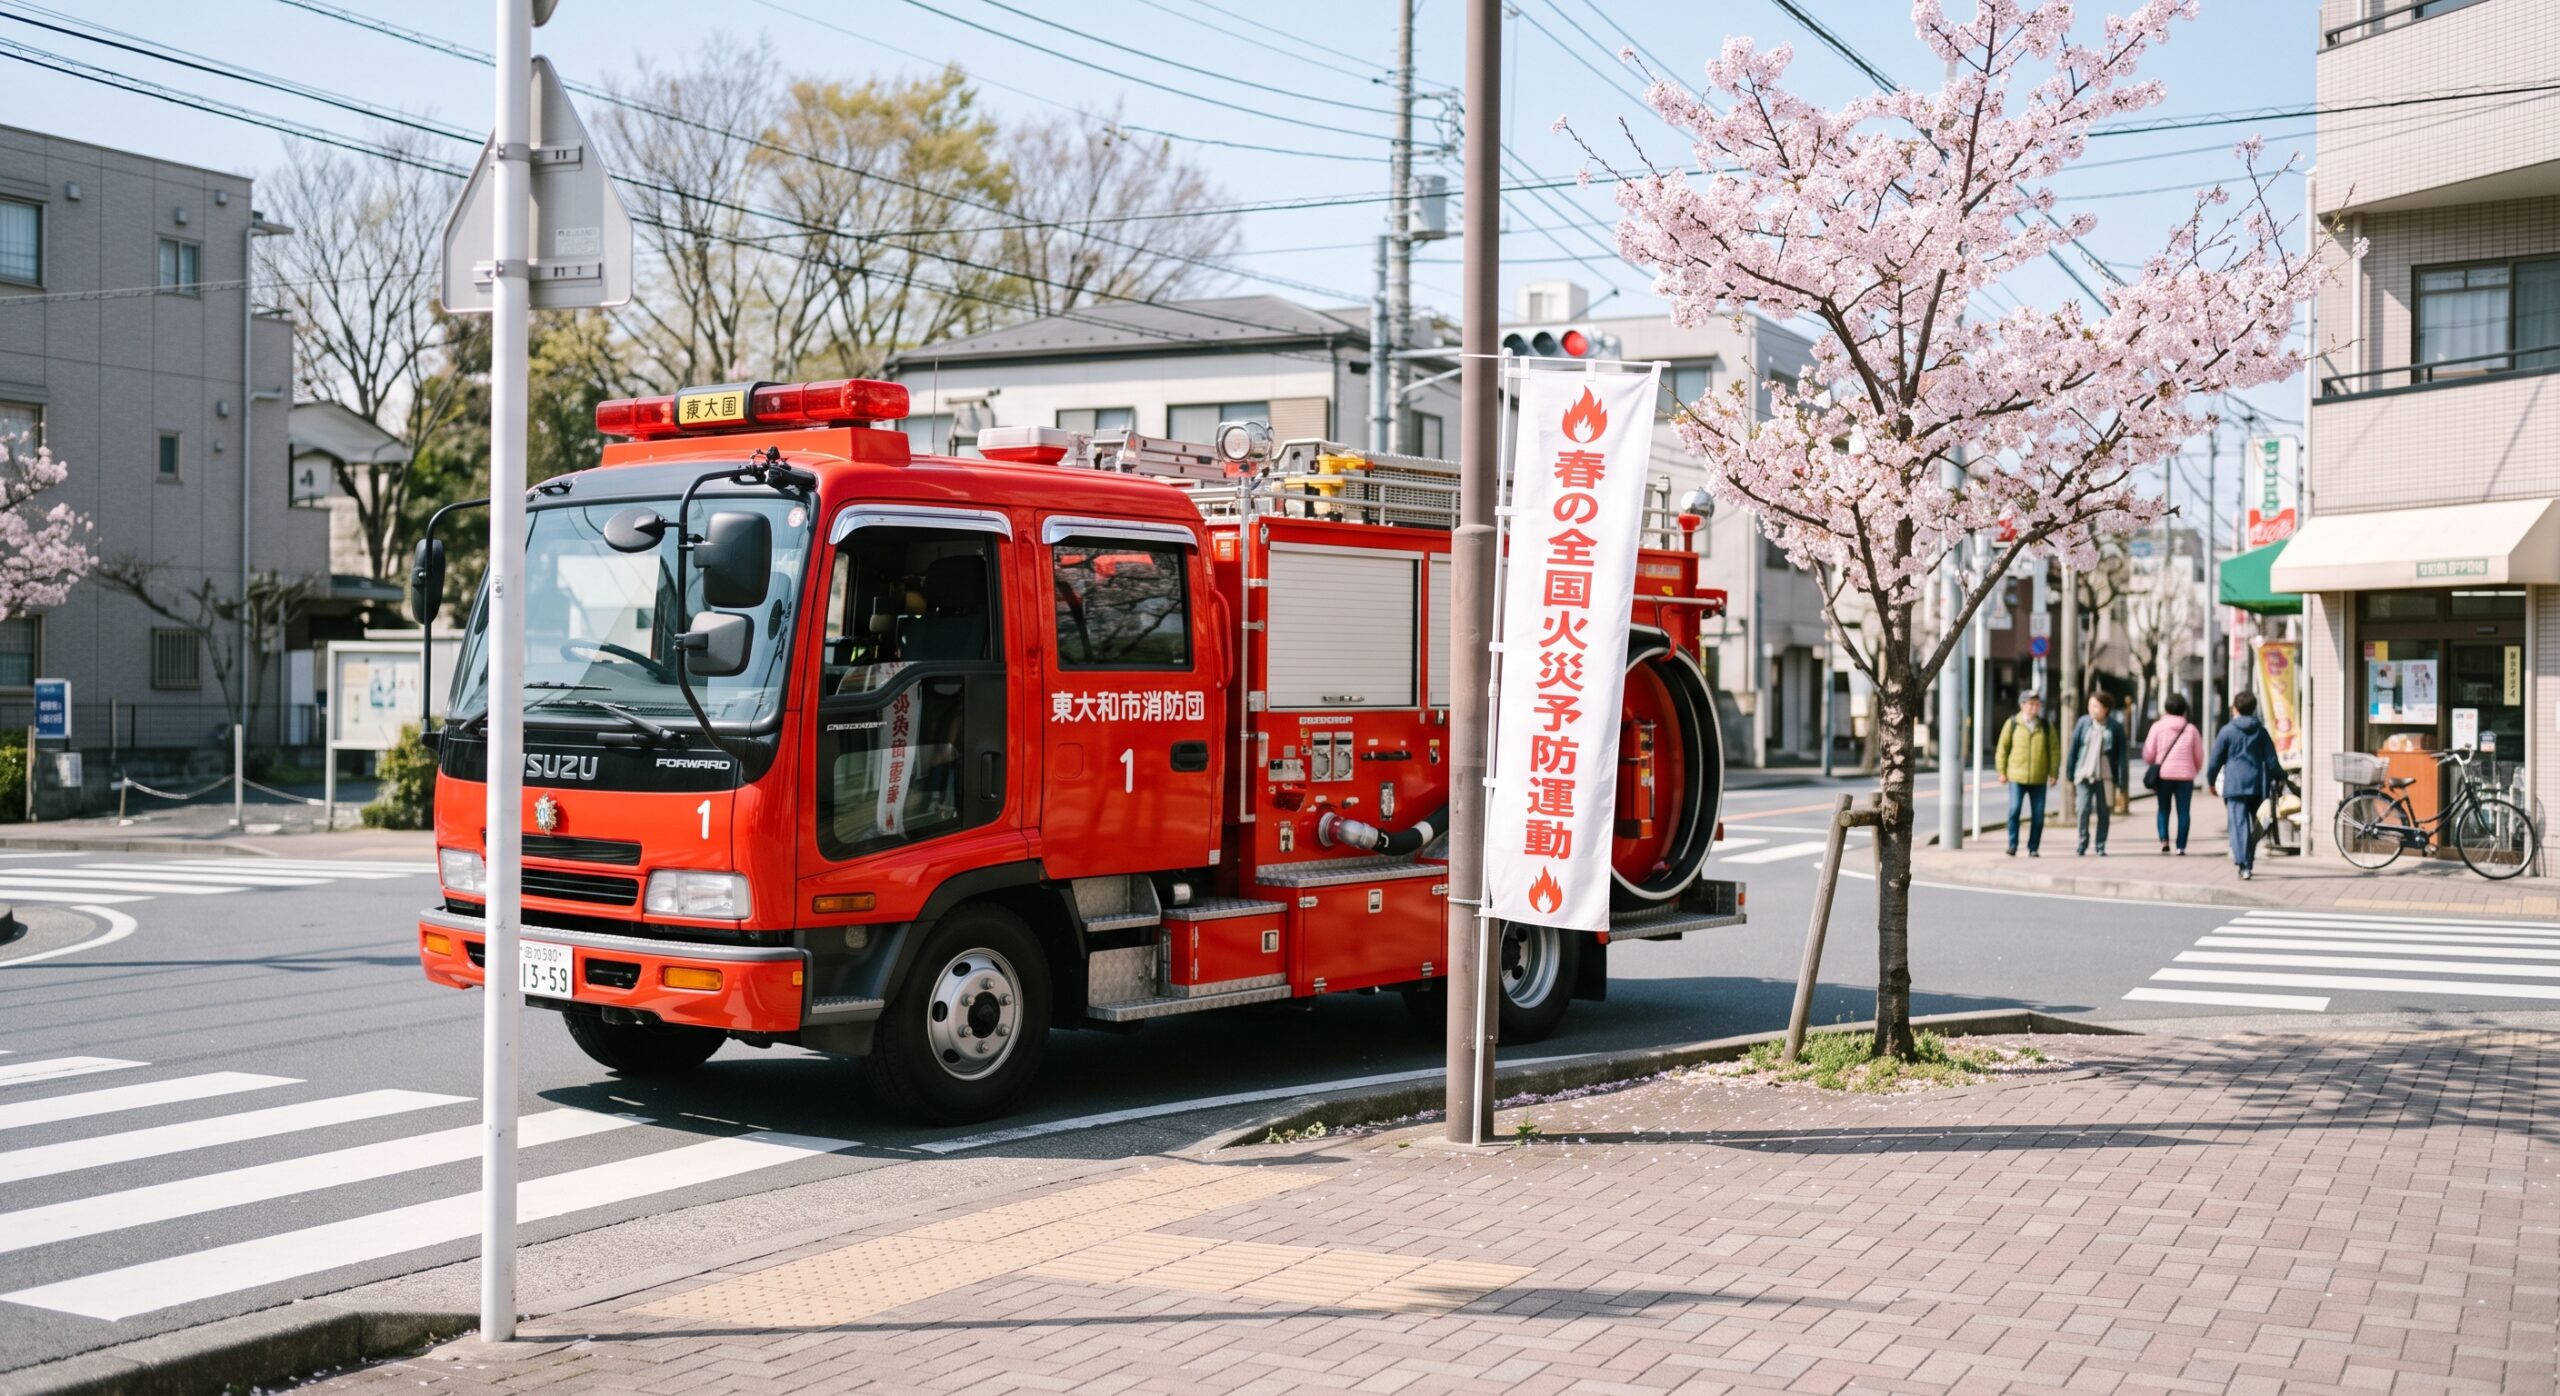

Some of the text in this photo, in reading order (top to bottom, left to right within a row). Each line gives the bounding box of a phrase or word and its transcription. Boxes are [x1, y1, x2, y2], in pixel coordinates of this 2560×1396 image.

[1523, 449, 1605, 860] 春の全国火災予防運動
[1051, 690, 1205, 723] 東大和市消防団
[655, 758, 731, 770] FORWARD
[1119, 748, 1134, 793] 1
[697, 800, 711, 840] 1
[523, 963, 568, 993] 13-59
